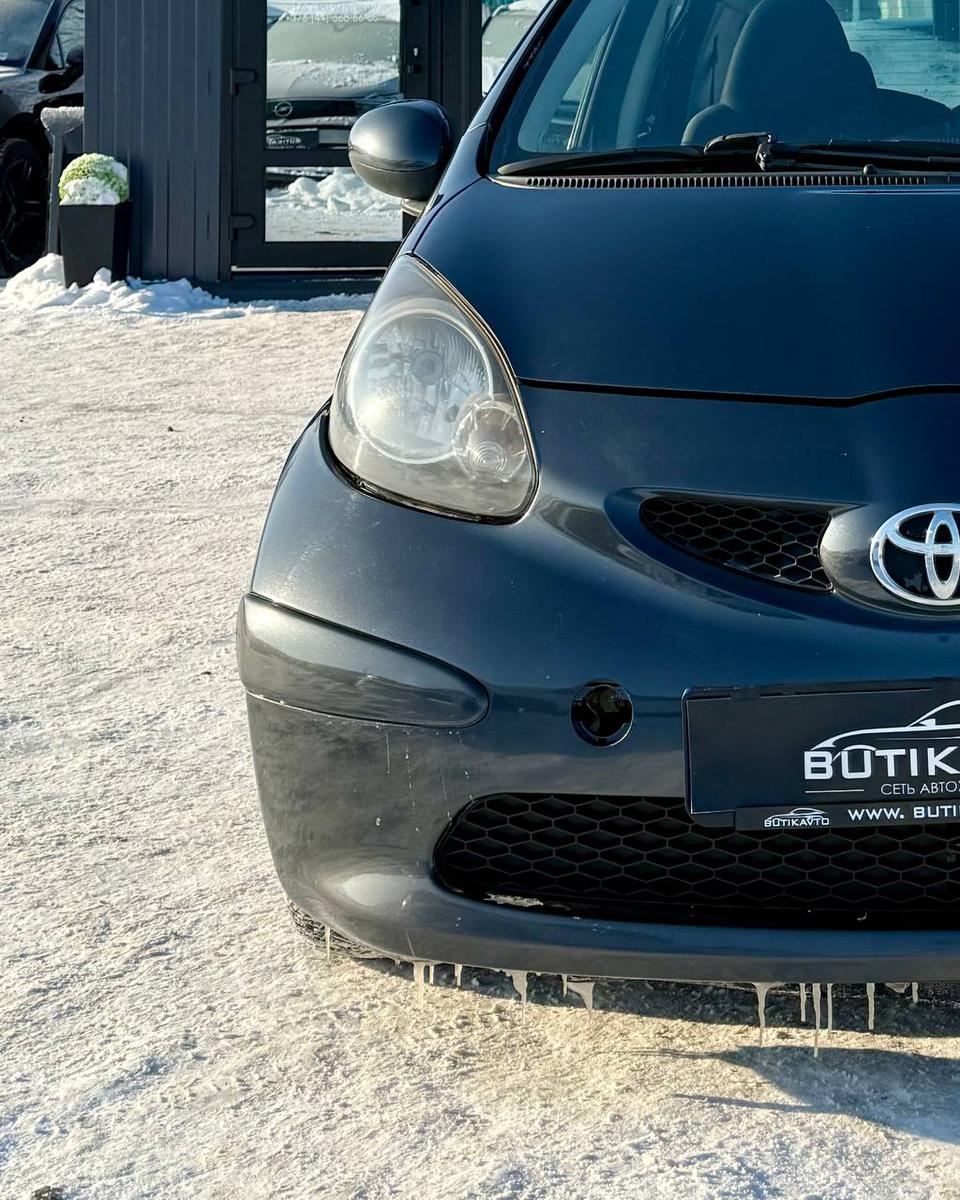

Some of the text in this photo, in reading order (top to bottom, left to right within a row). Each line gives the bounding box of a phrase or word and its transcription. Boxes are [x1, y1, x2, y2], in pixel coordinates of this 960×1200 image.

[880, 782, 916, 796] СЕТЬ
[847, 808, 905, 821] WWW.
[763, 816, 830, 828] BUTIKAVTO
